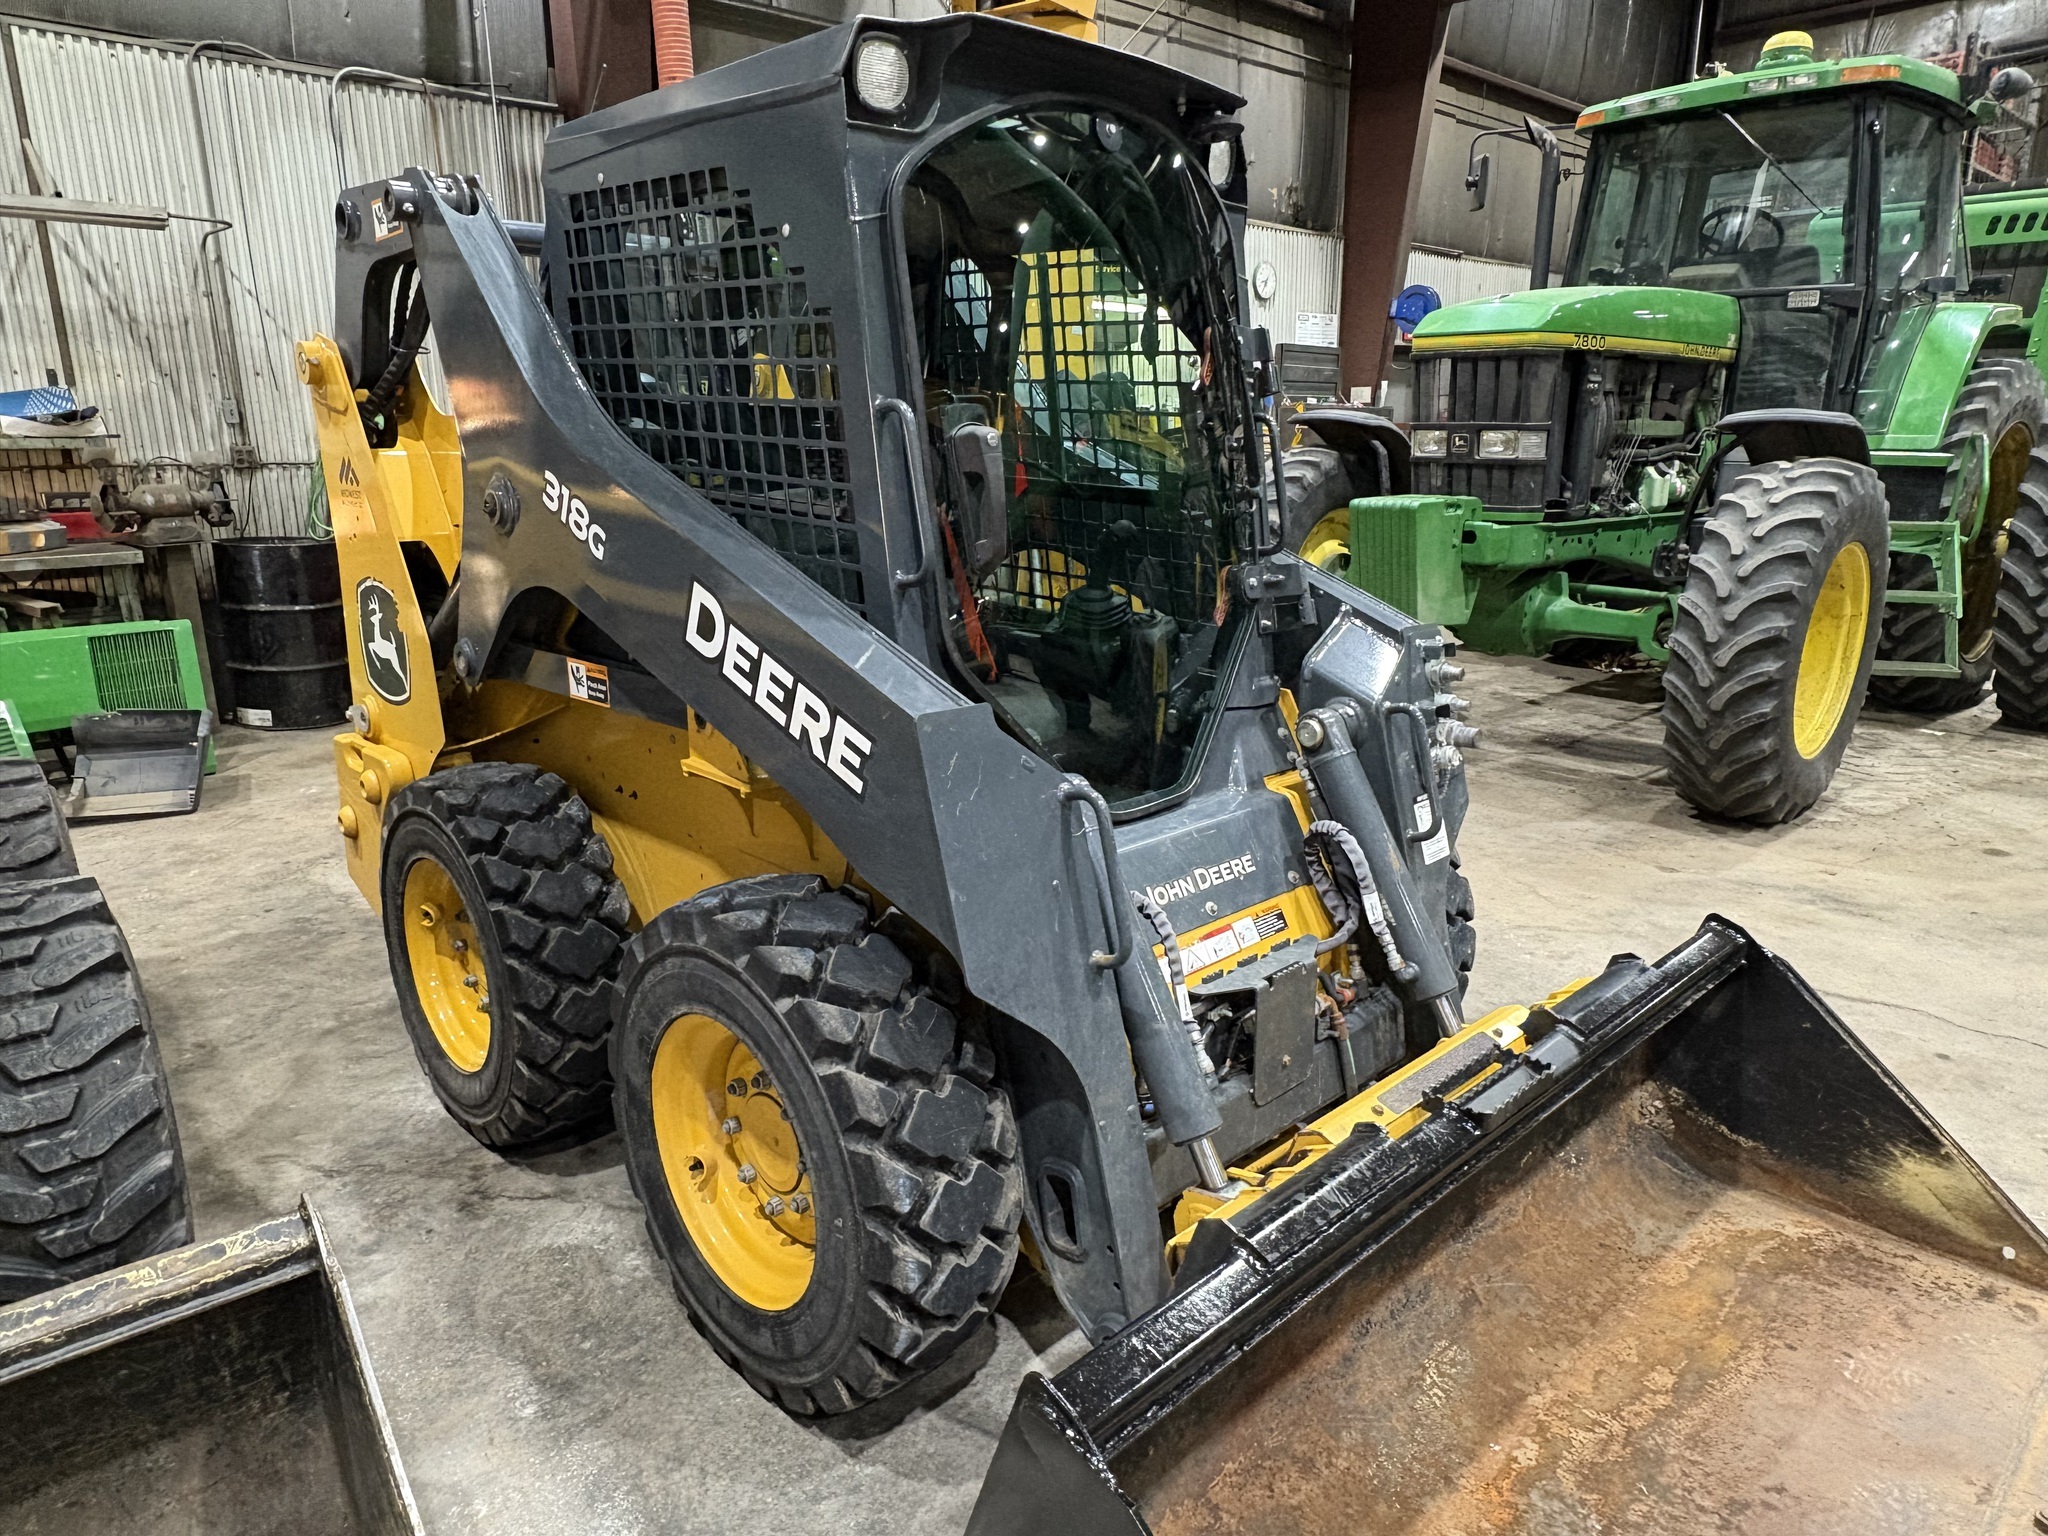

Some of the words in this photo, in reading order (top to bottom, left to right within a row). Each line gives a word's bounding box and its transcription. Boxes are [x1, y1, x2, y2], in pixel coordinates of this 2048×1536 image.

[1573, 334, 1606, 349] 7800
[1681, 343, 1700, 357] JOHN
[542, 469, 607, 561] 318G
[685, 580, 872, 795] DEERE
[1145, 875, 1196, 906] JOHN
[1193, 854, 1257, 891] DEERE
